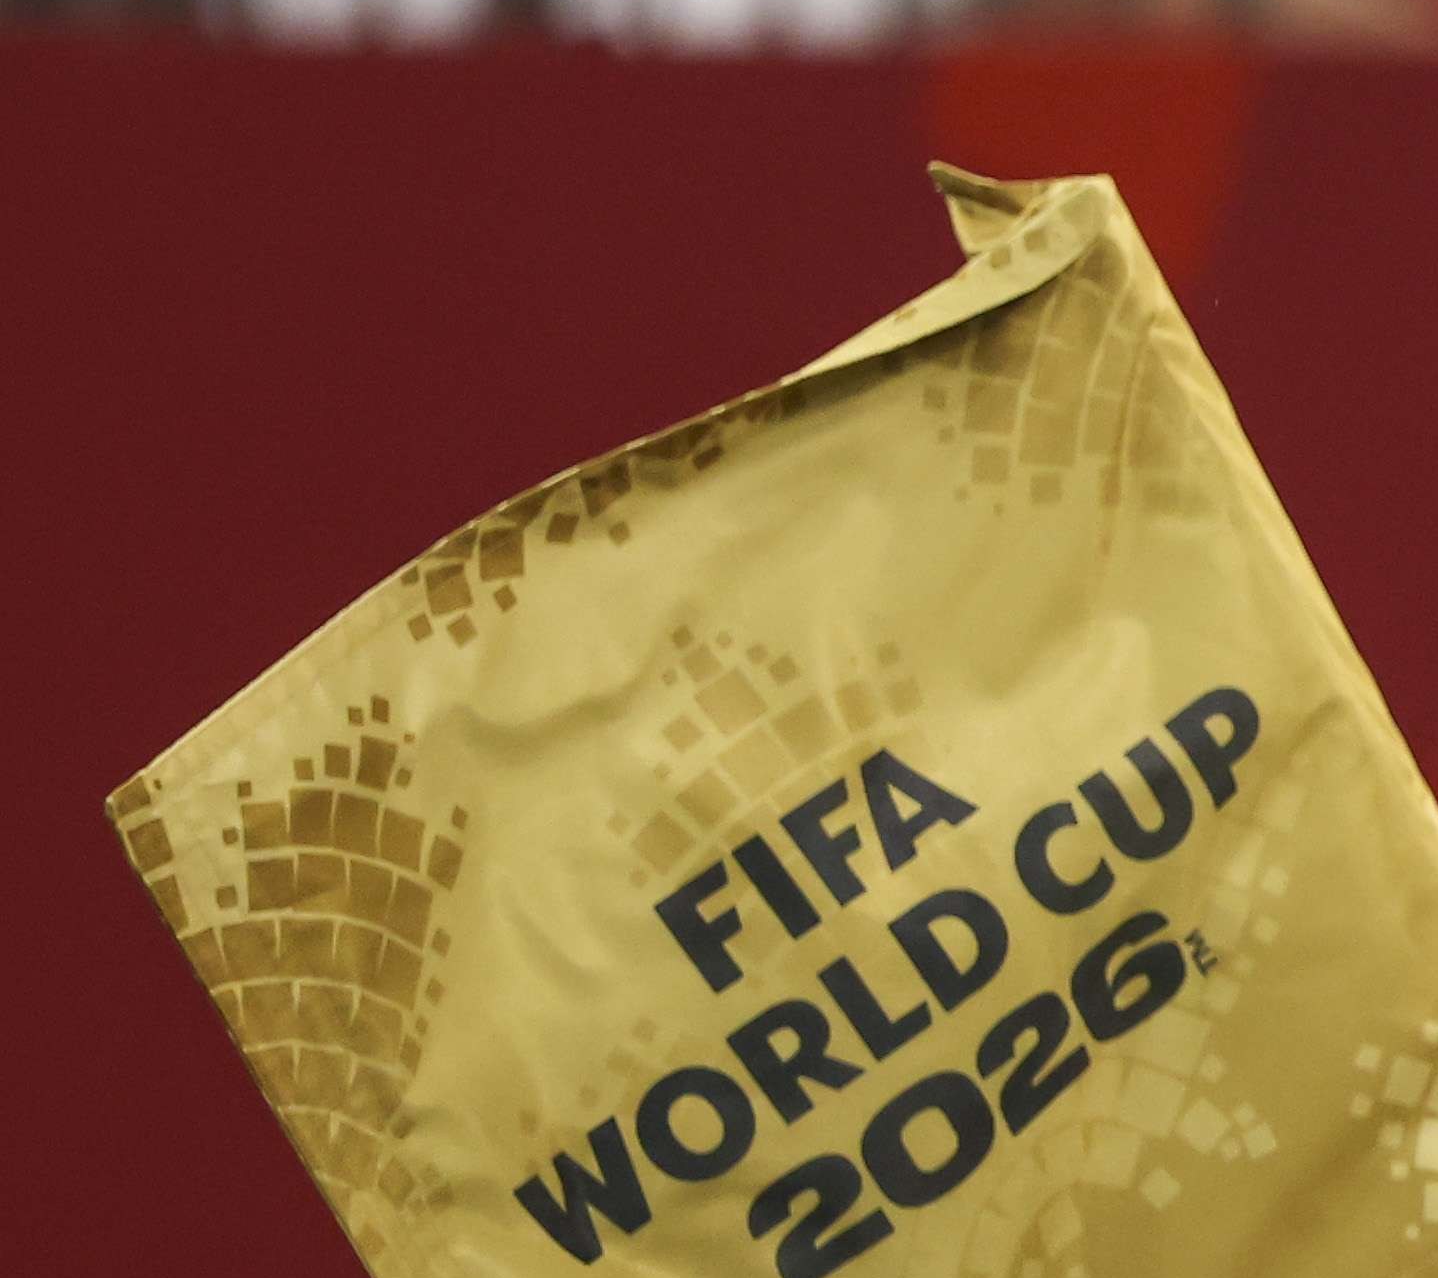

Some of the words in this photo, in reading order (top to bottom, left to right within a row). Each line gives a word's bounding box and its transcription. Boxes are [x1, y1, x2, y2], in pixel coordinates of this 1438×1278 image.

[514, 890, 1008, 1265] WORLD
[1015, 689, 1258, 915] CUP
[655, 750, 976, 993] FIFA
